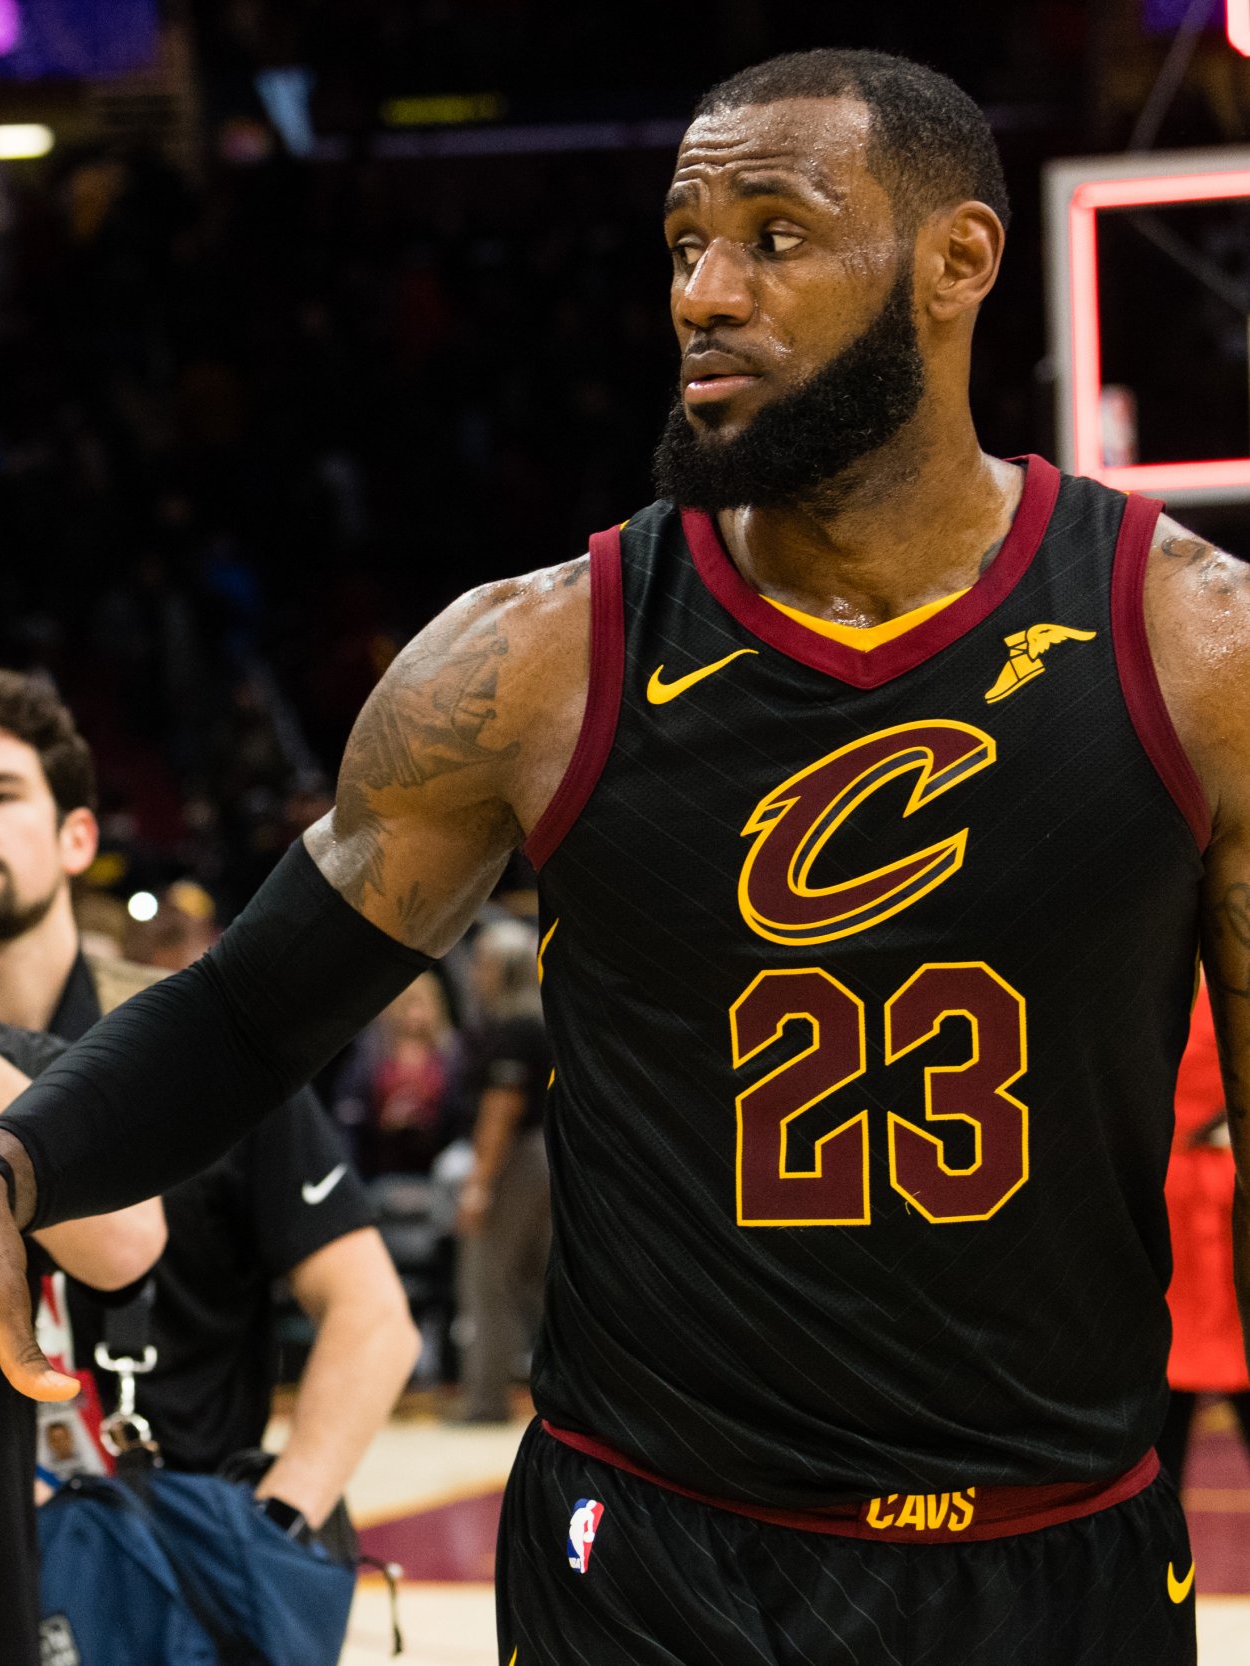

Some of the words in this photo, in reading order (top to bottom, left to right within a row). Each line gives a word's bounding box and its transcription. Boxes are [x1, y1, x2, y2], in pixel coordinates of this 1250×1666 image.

[738, 718, 997, 946] C
[729, 961, 1029, 1226] 23
[865, 1486, 976, 1532] CAVS
